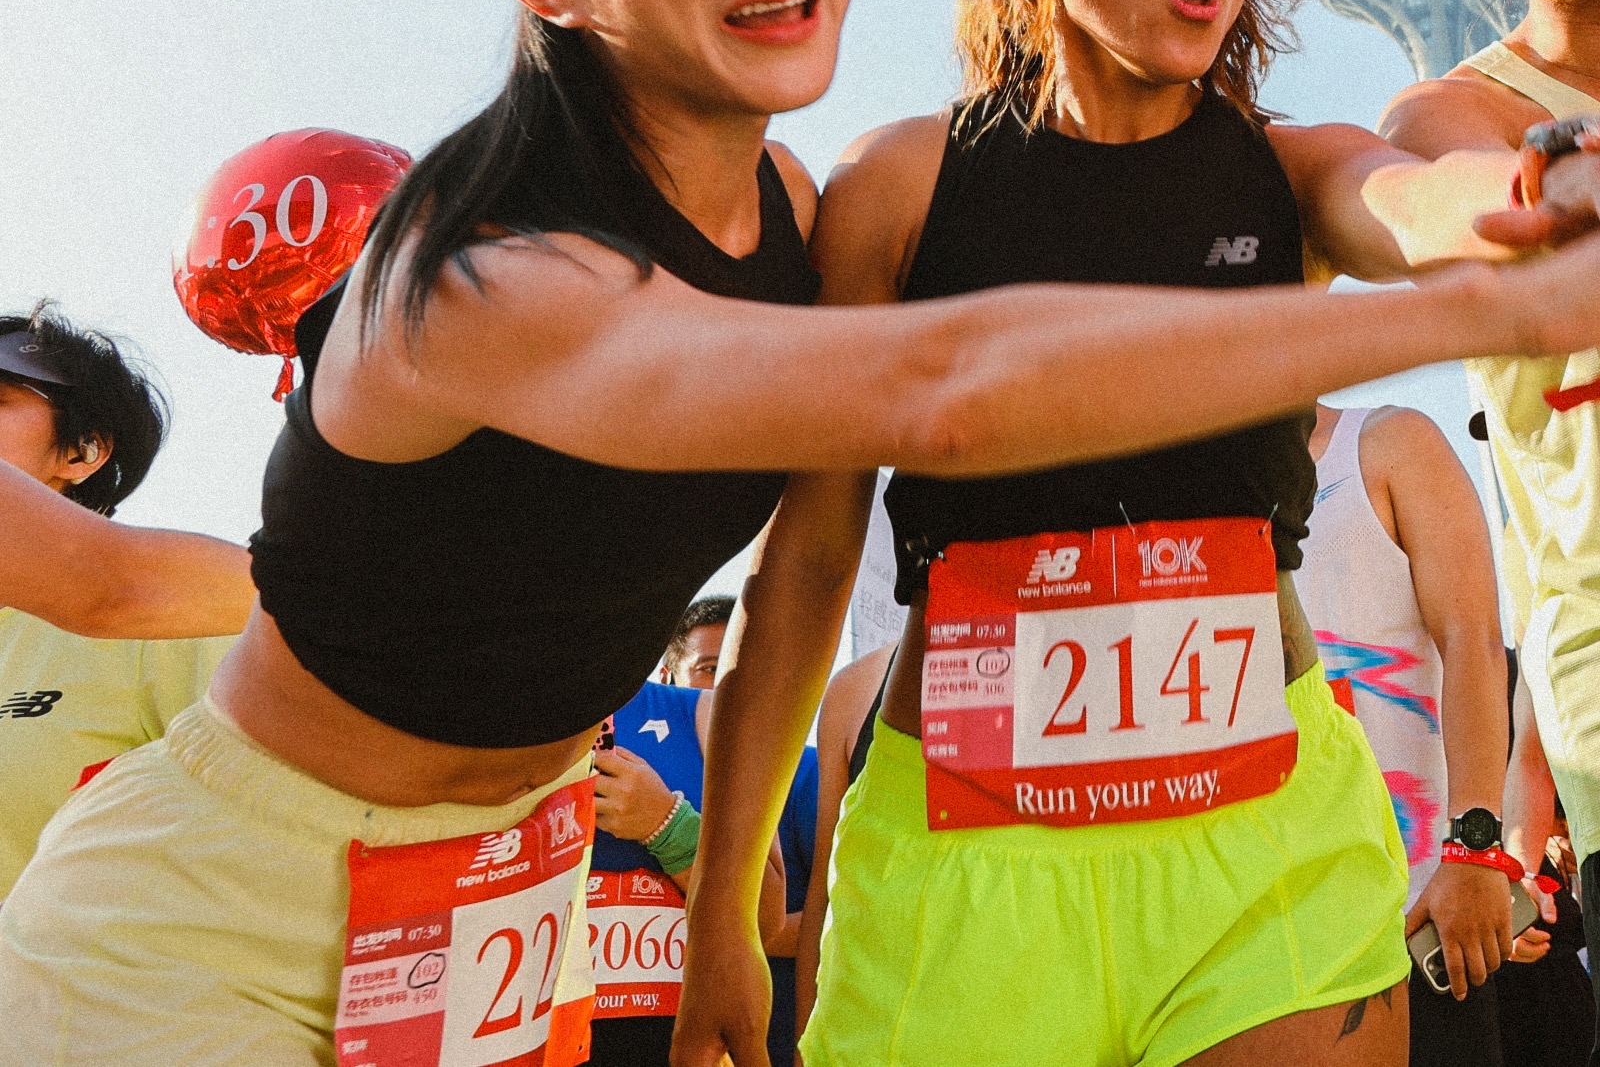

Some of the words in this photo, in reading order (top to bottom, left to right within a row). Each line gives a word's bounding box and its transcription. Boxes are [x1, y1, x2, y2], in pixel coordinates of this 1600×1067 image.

[1137, 535, 1207, 577] 10K
[1017, 585, 1041, 599] new
[1042, 581, 1091, 597] balance
[1040, 617, 1256, 738] 2147
[1015, 781, 1077, 815] Run
[1087, 778, 1156, 820] your
[1164, 767, 1222, 806] way.
[547, 801, 583, 848] 10K
[455, 873, 486, 888] new
[487, 861, 531, 883] balance
[632, 875, 665, 894] 10K
[407, 924, 442, 942] 07:30
[472, 900, 572, 1038] 22
[631, 993, 660, 1011] way.
